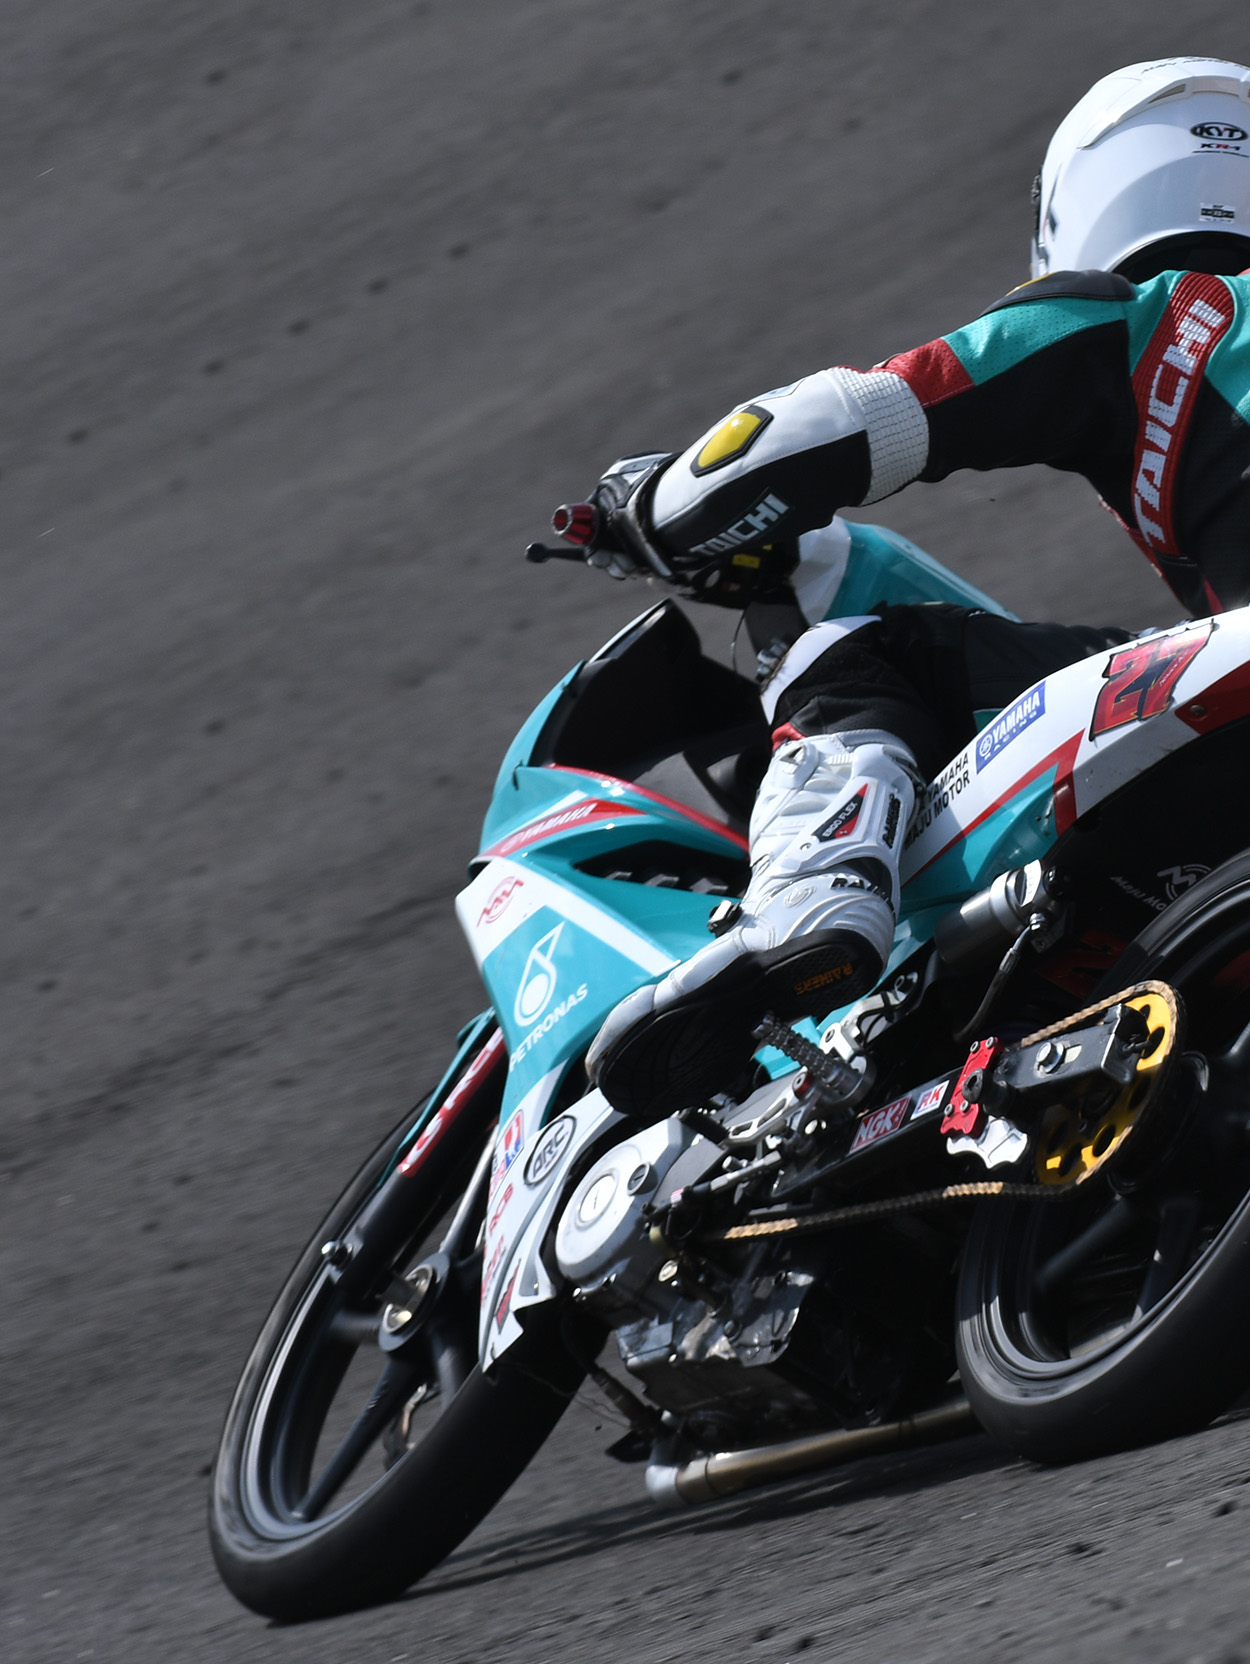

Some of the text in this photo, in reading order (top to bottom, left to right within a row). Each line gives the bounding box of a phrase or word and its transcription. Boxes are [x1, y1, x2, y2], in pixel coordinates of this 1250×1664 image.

[1199, 125, 1242, 138] KYT
[1134, 299, 1226, 547] TAICHI
[689, 493, 789, 556] TAICHI
[1089, 622, 1213, 740] 27
[993, 691, 1041, 745] YAMAHA
[933, 770, 971, 819] MOTOR
[822, 819, 843, 837] ERGO
[509, 983, 588, 1074] PETRONAS
[918, 1085, 945, 1111] RK
[533, 1123, 567, 1179] ARC
